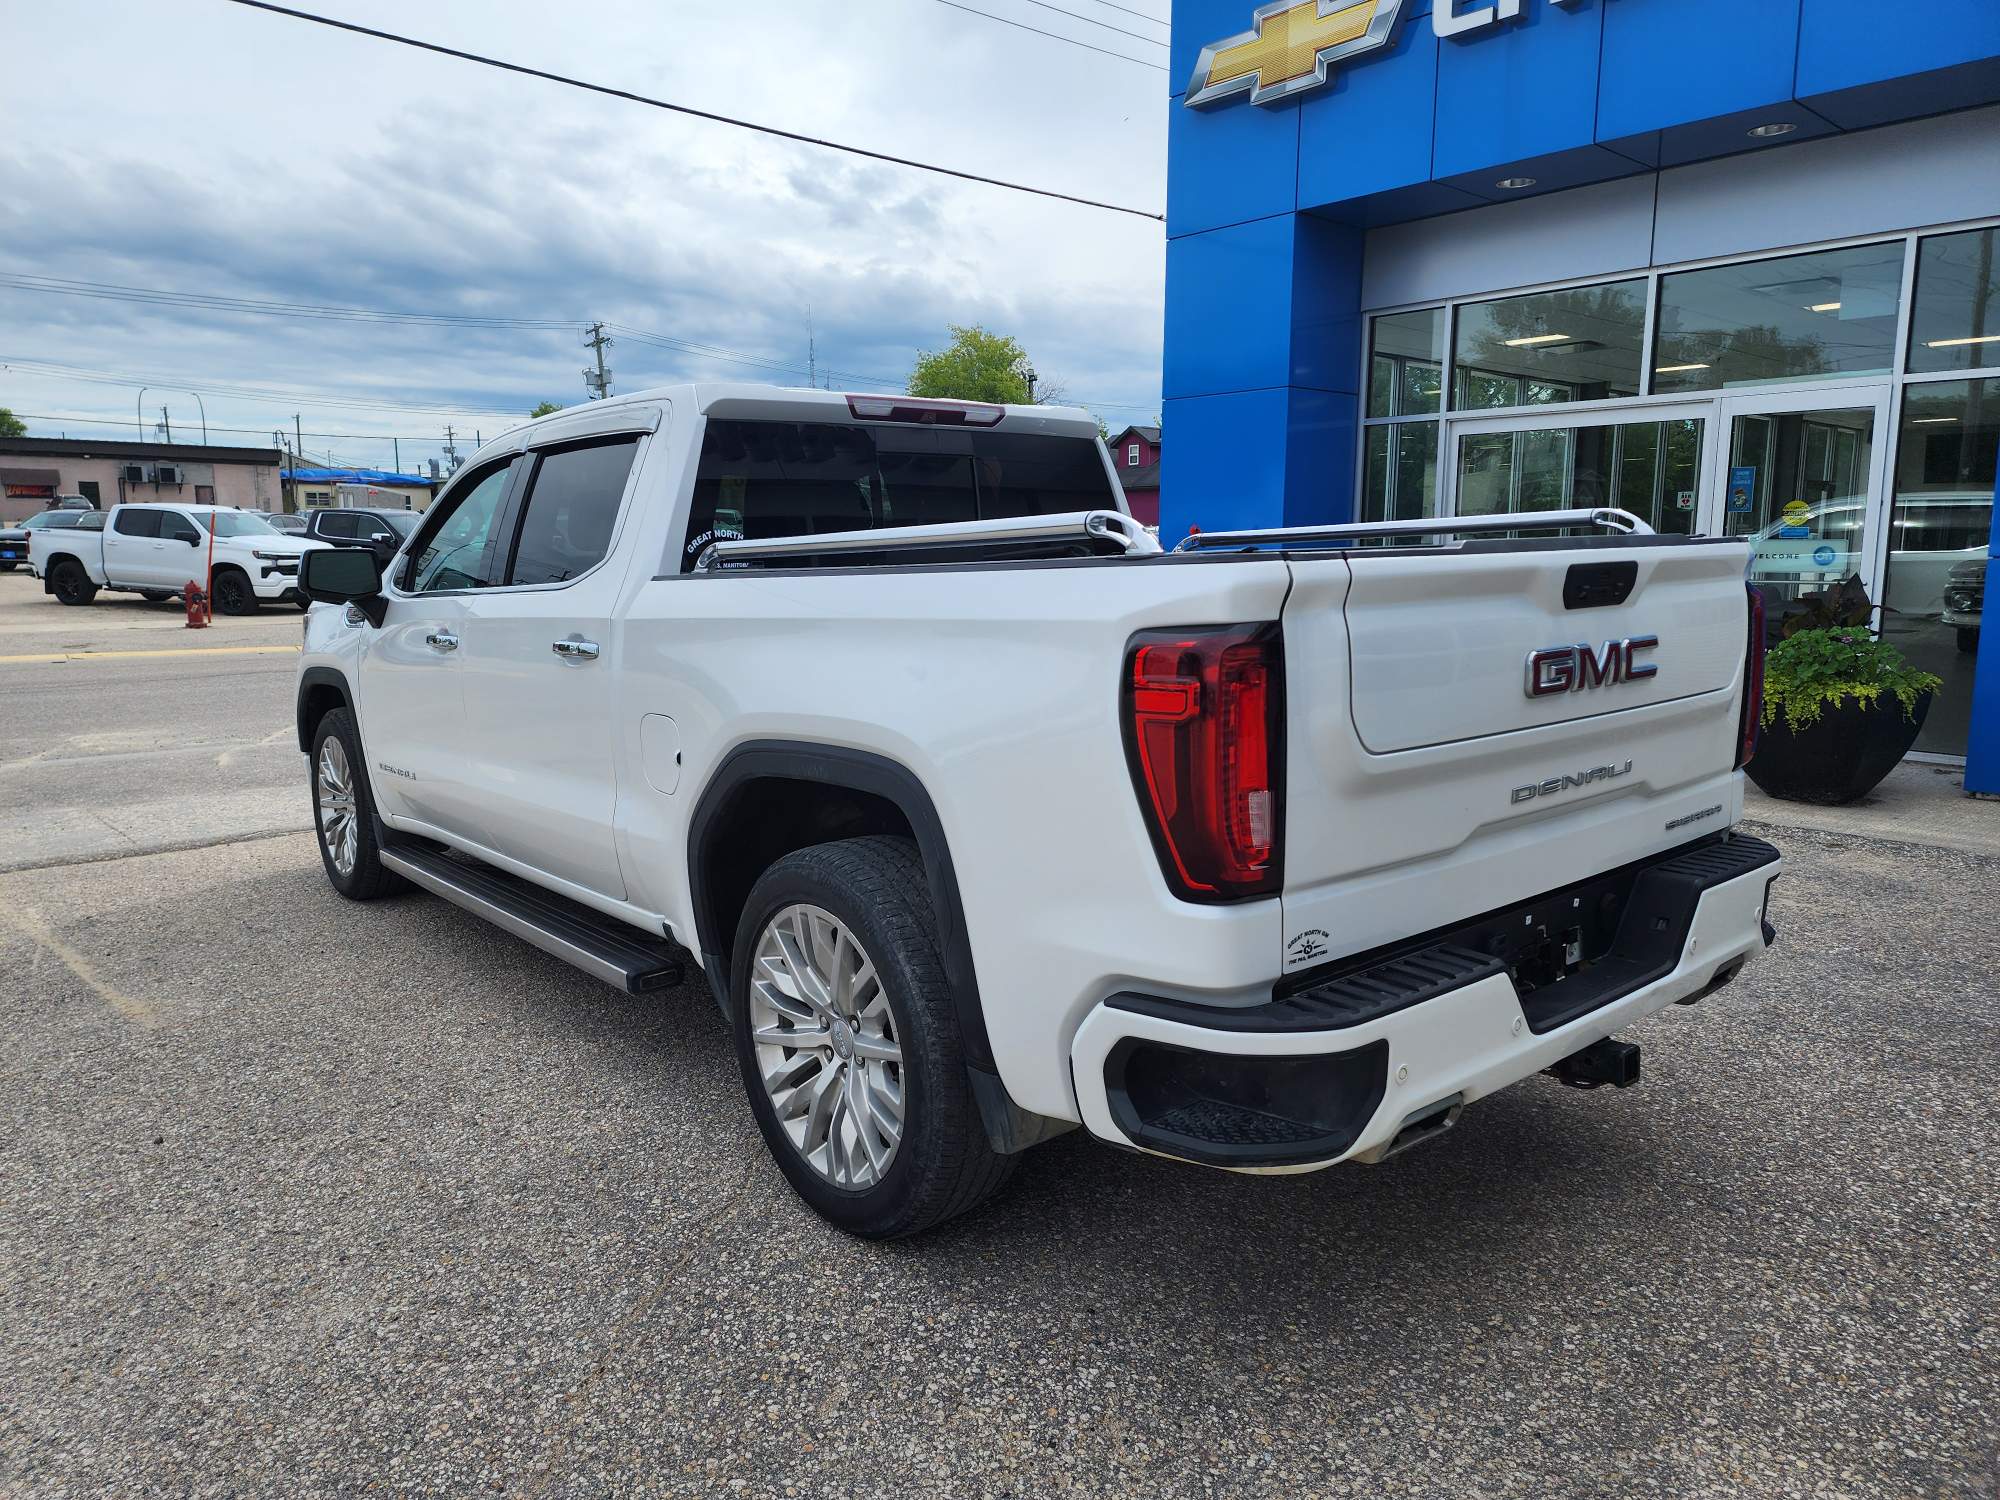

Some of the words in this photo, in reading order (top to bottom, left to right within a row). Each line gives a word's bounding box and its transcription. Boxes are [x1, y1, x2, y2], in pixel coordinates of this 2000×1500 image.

[687, 531, 712, 553] GREAT
[714, 529, 744, 540] NORTH
[1524, 634, 1660, 699] GMC
[1511, 758, 1634, 804] DENALI
[1288, 933, 1303, 949] GREAT
